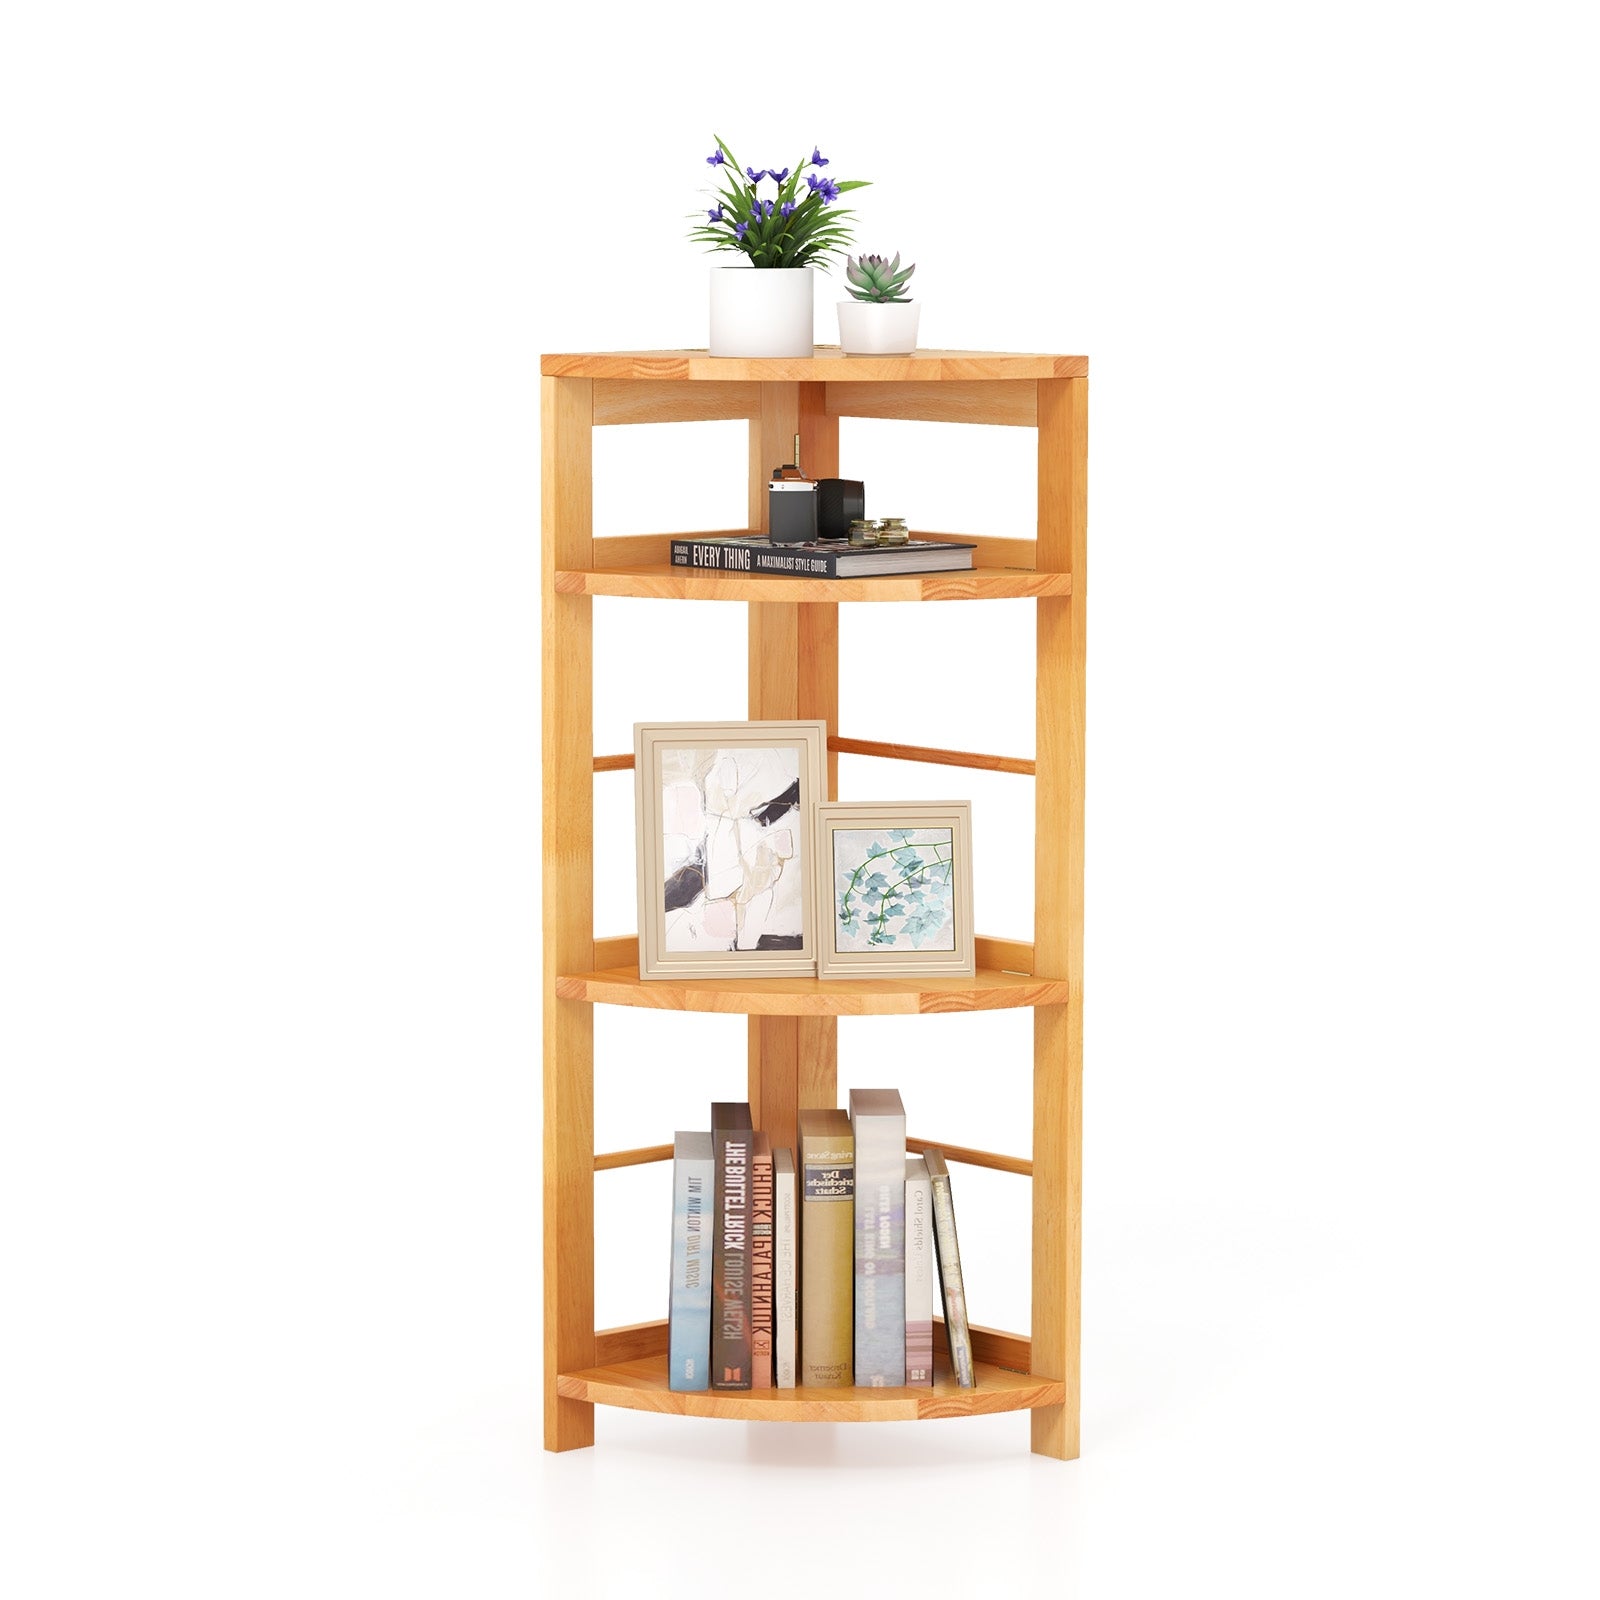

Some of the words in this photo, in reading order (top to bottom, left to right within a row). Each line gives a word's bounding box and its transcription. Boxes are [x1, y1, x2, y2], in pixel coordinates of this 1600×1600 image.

[693, 544, 720, 568] EVERY
[723, 547, 751, 570] THING
[756, 554, 761, 567] A
[761, 555, 795, 570] MAXIMALIST
[795, 557, 811, 571] STYLE
[811, 559, 828, 573] GUIDE
